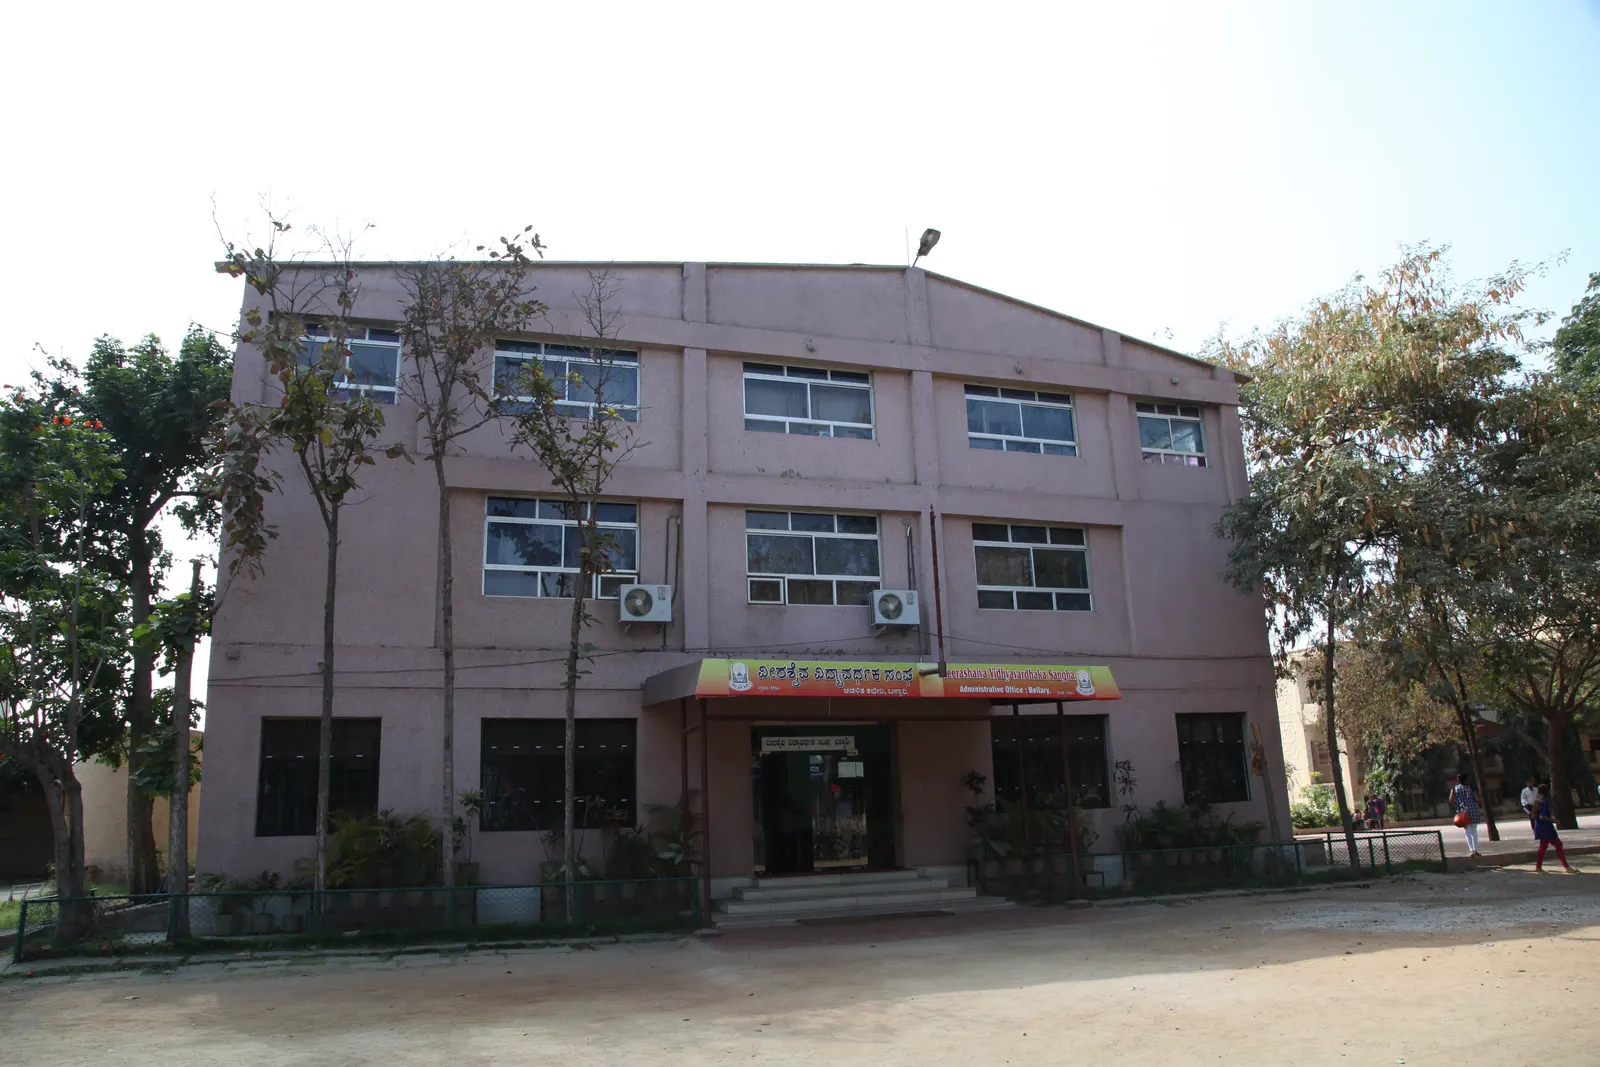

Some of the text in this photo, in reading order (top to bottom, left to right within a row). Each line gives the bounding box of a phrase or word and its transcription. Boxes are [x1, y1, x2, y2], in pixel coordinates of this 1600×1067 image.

[758, 661, 809, 688] ವೀರಶೈವ
[814, 666, 880, 688] ವಿದ್ಯಾವರ್ಧಕ
[884, 667, 913, 686] ಸಂಘ
[945, 667, 1075, 683] eerashaiva Vidhyavardhaka Sangha
[959, 685, 1004, 693] Administrative
[1028, 686, 1052, 695] Bellary.
